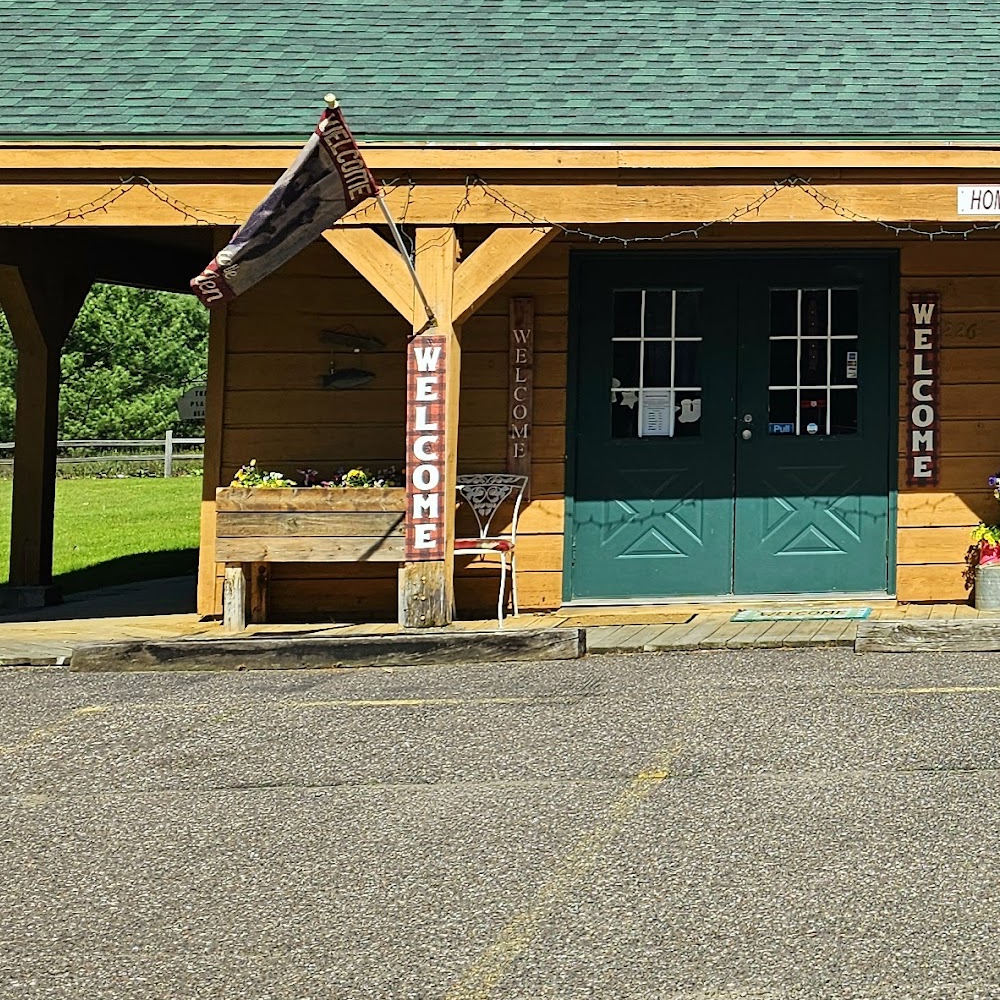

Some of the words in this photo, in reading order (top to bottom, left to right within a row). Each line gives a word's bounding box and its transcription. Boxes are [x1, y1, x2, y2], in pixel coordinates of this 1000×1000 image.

[318, 111, 372, 201] WELCOME
[511, 329, 531, 458] WELCOME
[773, 424, 791, 433] Pull
[911, 303, 935, 478] WELCOME
[412, 346, 442, 549] WELCOME
[760, 609, 847, 617] WELCOME
